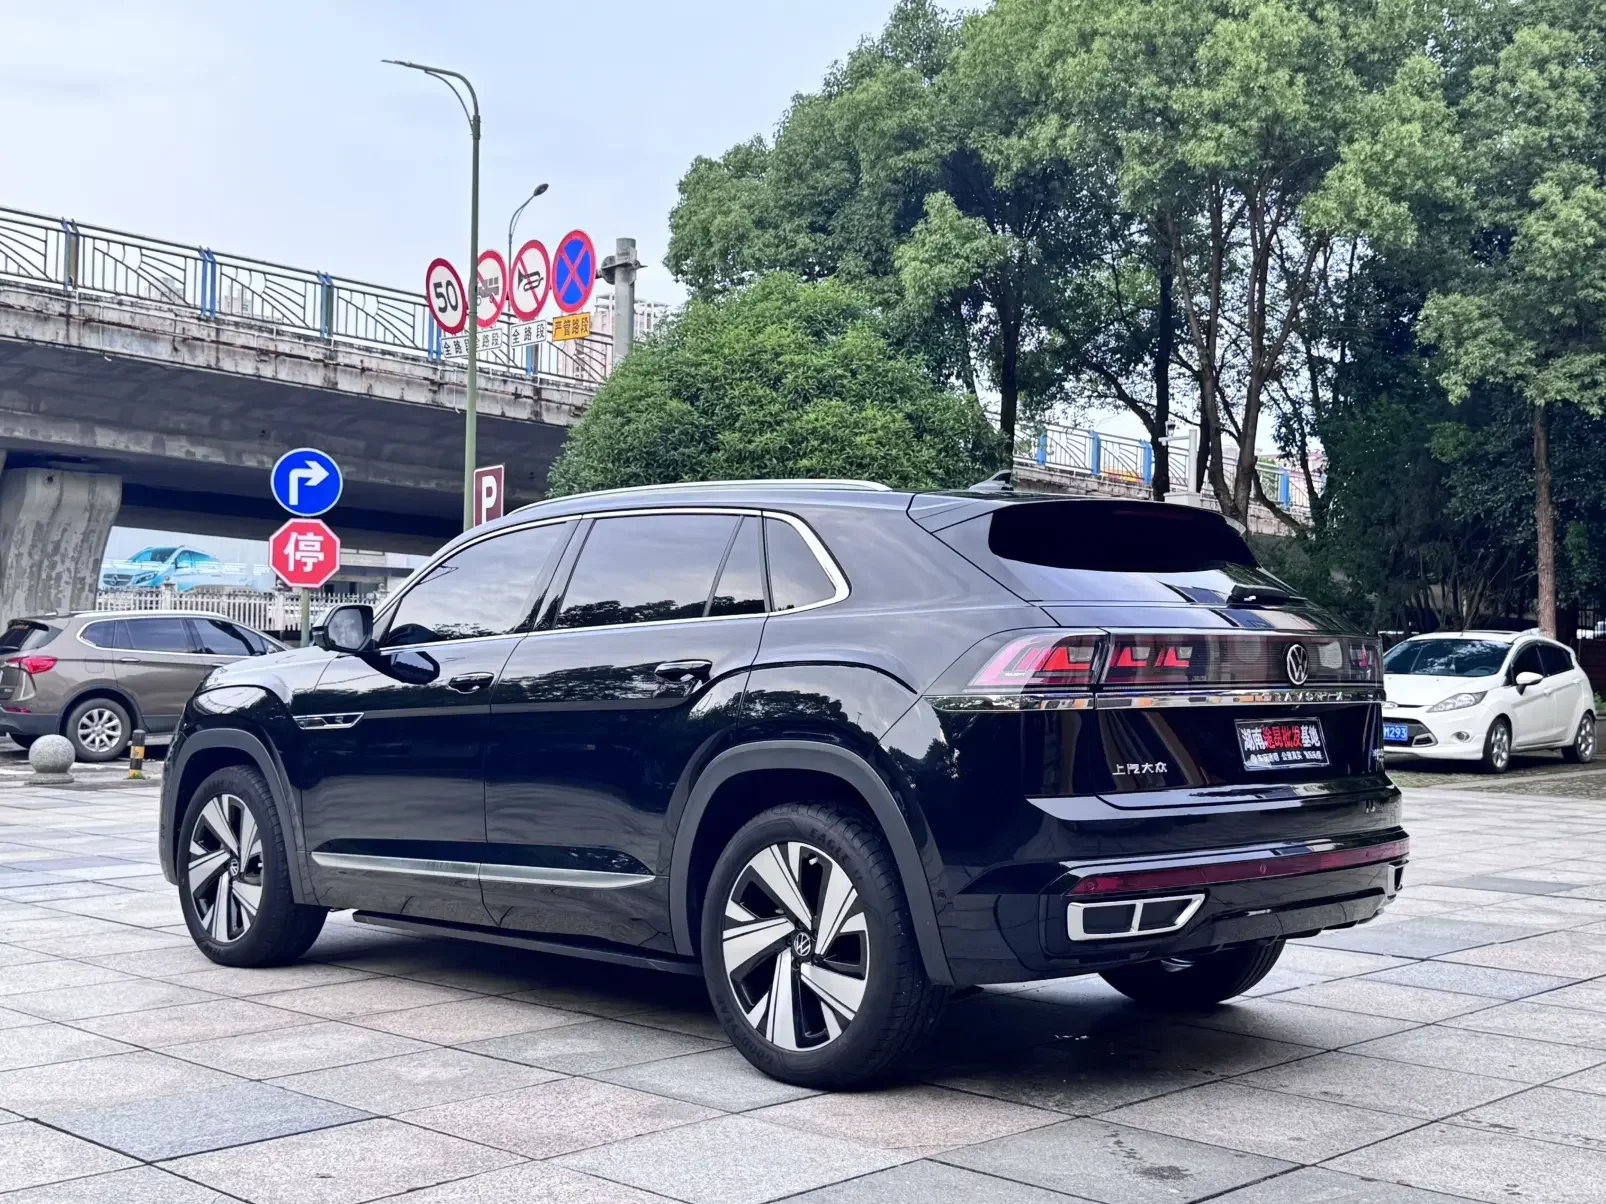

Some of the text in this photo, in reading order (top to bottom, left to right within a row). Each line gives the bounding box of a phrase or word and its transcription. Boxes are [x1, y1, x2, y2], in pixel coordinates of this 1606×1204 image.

[433, 280, 458, 313] 50
[512, 323, 545, 344] 全路段
[554, 317, 588, 337] 严管路段
[476, 332, 499, 348] 路段
[482, 475, 497, 524] P
[283, 532, 325, 572] 停
[1384, 727, 1406, 739] M293
[1112, 762, 1168, 775] 上汽大众
